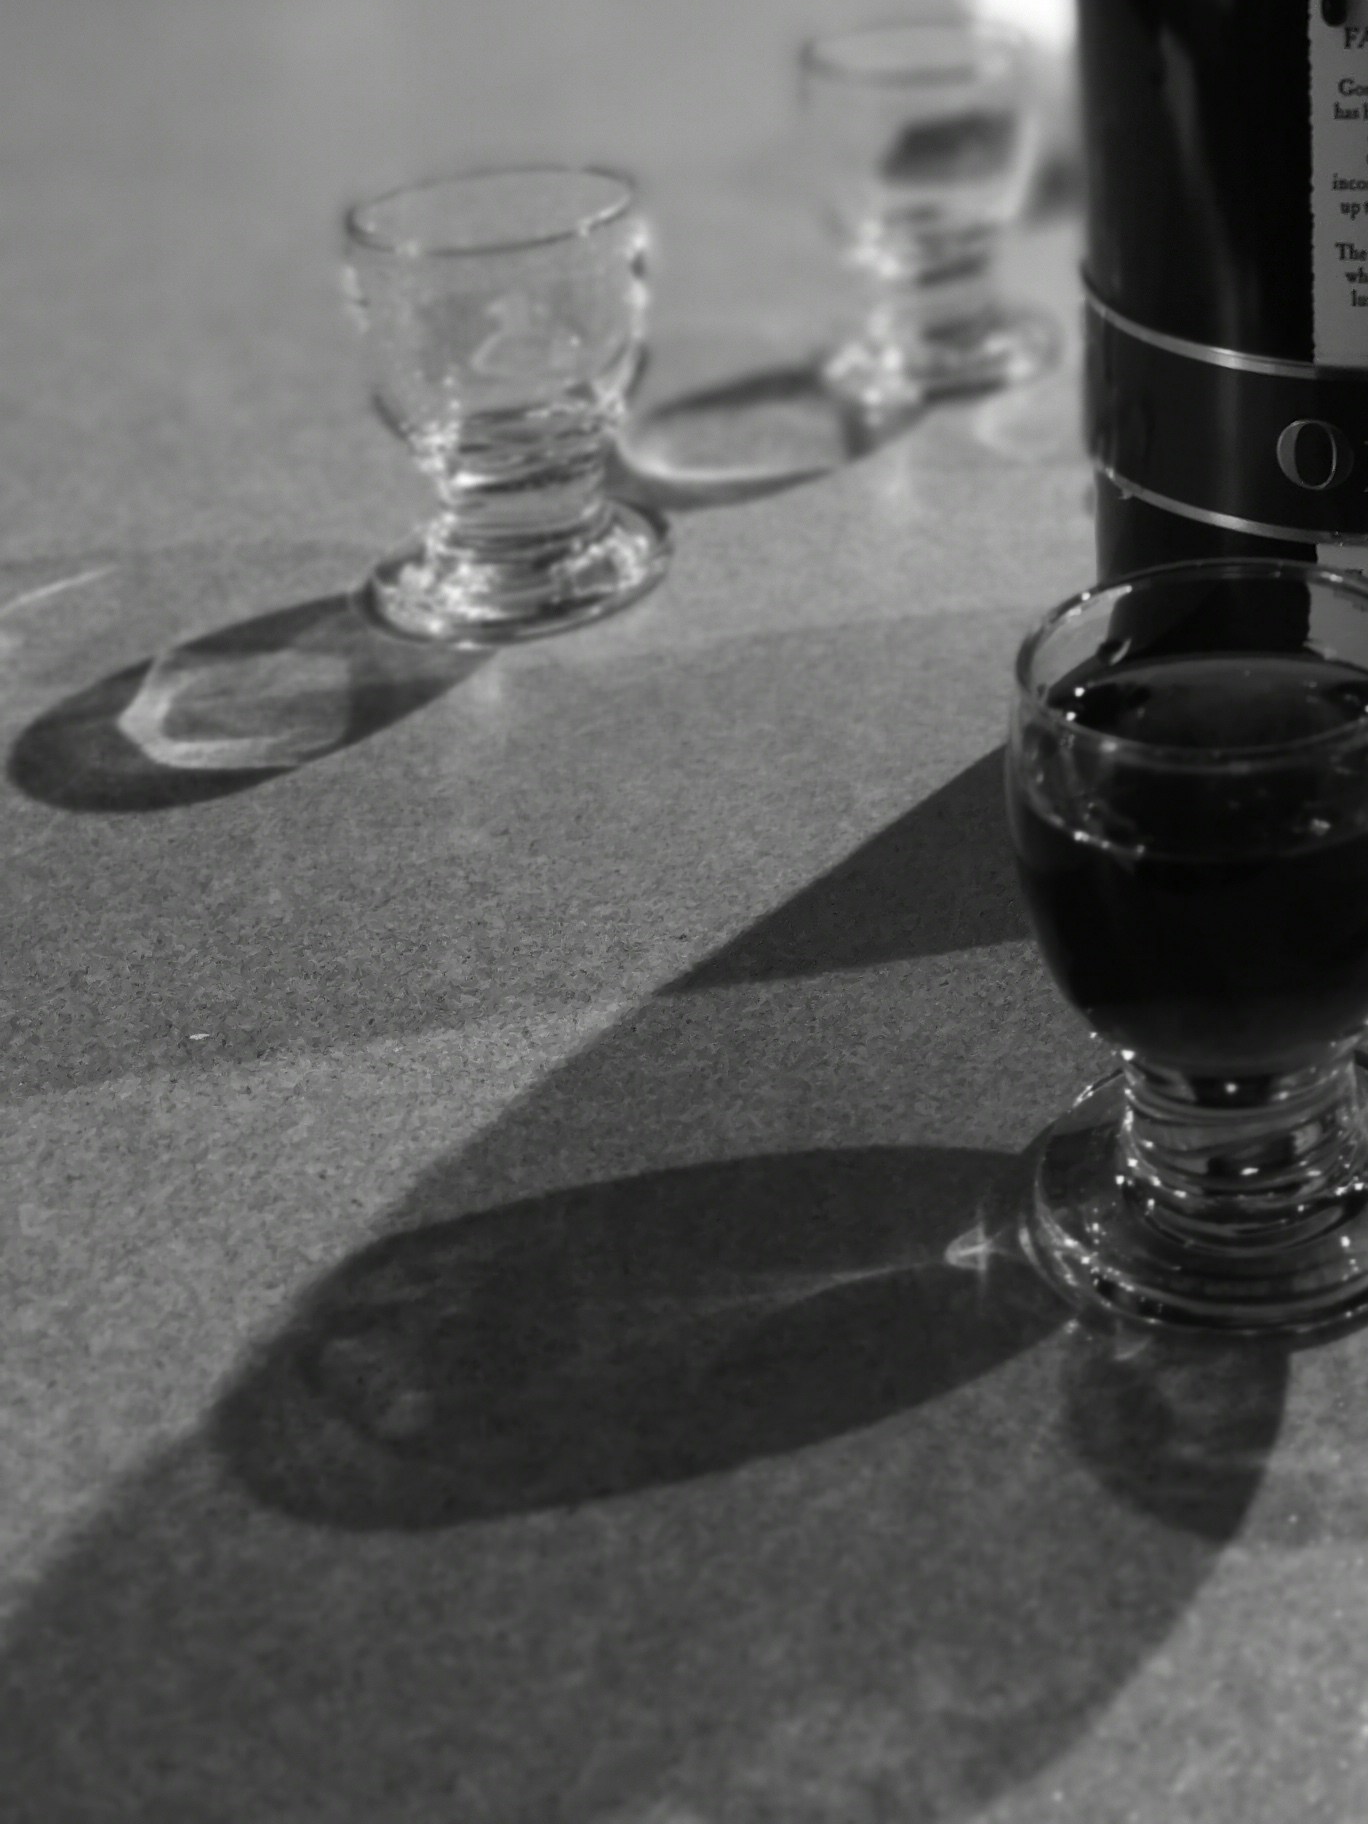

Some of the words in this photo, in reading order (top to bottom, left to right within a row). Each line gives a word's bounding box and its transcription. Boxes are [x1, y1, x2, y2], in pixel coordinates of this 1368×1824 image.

[1334, 101, 1360, 120] has
[1340, 201, 1361, 221] up
[1334, 241, 1368, 262] The
